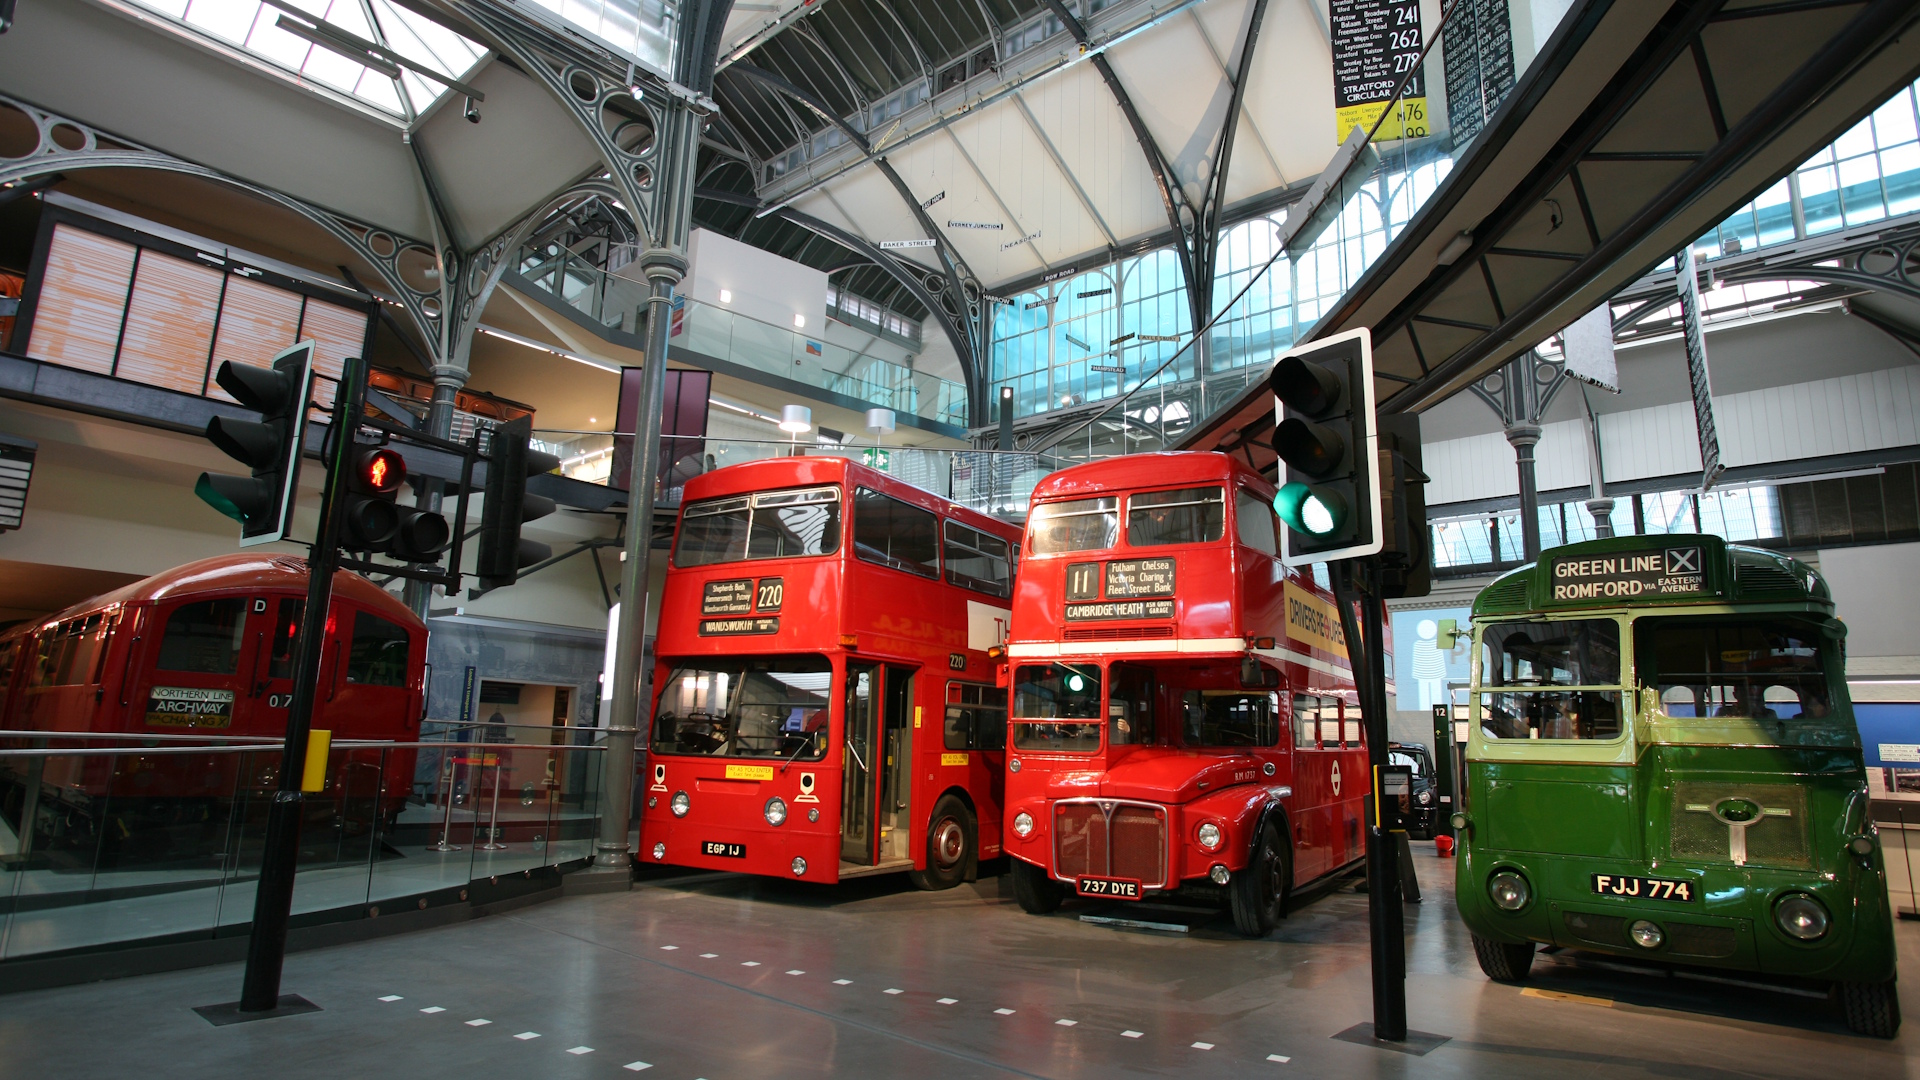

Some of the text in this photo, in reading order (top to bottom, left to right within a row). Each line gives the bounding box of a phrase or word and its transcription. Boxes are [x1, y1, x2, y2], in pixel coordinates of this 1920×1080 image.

[1333, 9, 1390, 22] Plaistow Broadway
[1365, 17, 1383, 25] Street
[1395, 5, 1418, 26] 241
[1338, 23, 1387, 36] Freemasons Road
[1334, 38, 1350, 46] Leyton
[1389, 29, 1420, 50] 262
[1345, 42, 1373, 51] Leytonstone
[1336, 51, 1358, 60] Stratford
[1337, 67, 1358, 75] Stratford
[1343, 80, 1394, 94] STRATFORD
[1347, 89, 1391, 102] CIRCULAR
[922, 193, 943, 210] EAST HAM
[1004, 234, 1037, 249] NEASDEN
[1045, 268, 1075, 281] BOW ROAD
[983, 294, 1010, 304] HARROW
[1037, 298, 1057, 308] HARROW
[1112, 561, 1169, 572] Fulham Chelsea
[1555, 550, 1696, 578] GREEN LINE X
[1074, 570, 1088, 593] 11
[1109, 574, 1135, 583] Victoria
[1140, 572, 1164, 583] Charing
[1658, 576, 1702, 586] EASTERN
[713, 583, 745, 593] Shepherds Bush
[1108, 583, 1171, 595] Fleet Street Bank
[1554, 580, 1643, 600] ROMFORD
[1660, 584, 1699, 593] AVENUE
[705, 593, 751, 602] Hammersmith Putney
[758, 585, 783, 607] 220
[254, 600, 266, 612] D
[704, 604, 728, 612] Wandsworth
[1068, 603, 1142, 617] CAMBRIDGE HEATH
[1290, 597, 1316, 634] DRIVERS
[706, 620, 753, 632] WANDSWORTH
[950, 655, 963, 668] 220
[152, 688, 232, 700] NORTHERN LINE
[156, 701, 224, 714] ARCHWAY
[1435, 708, 1445, 717] 12
[160, 714, 215, 726] CHARING
[219, 718, 228, 726] X
[707, 843, 725, 854] EGP
[1083, 880, 1135, 895] 737 DYE
[1597, 875, 1689, 900] FJJ 774
